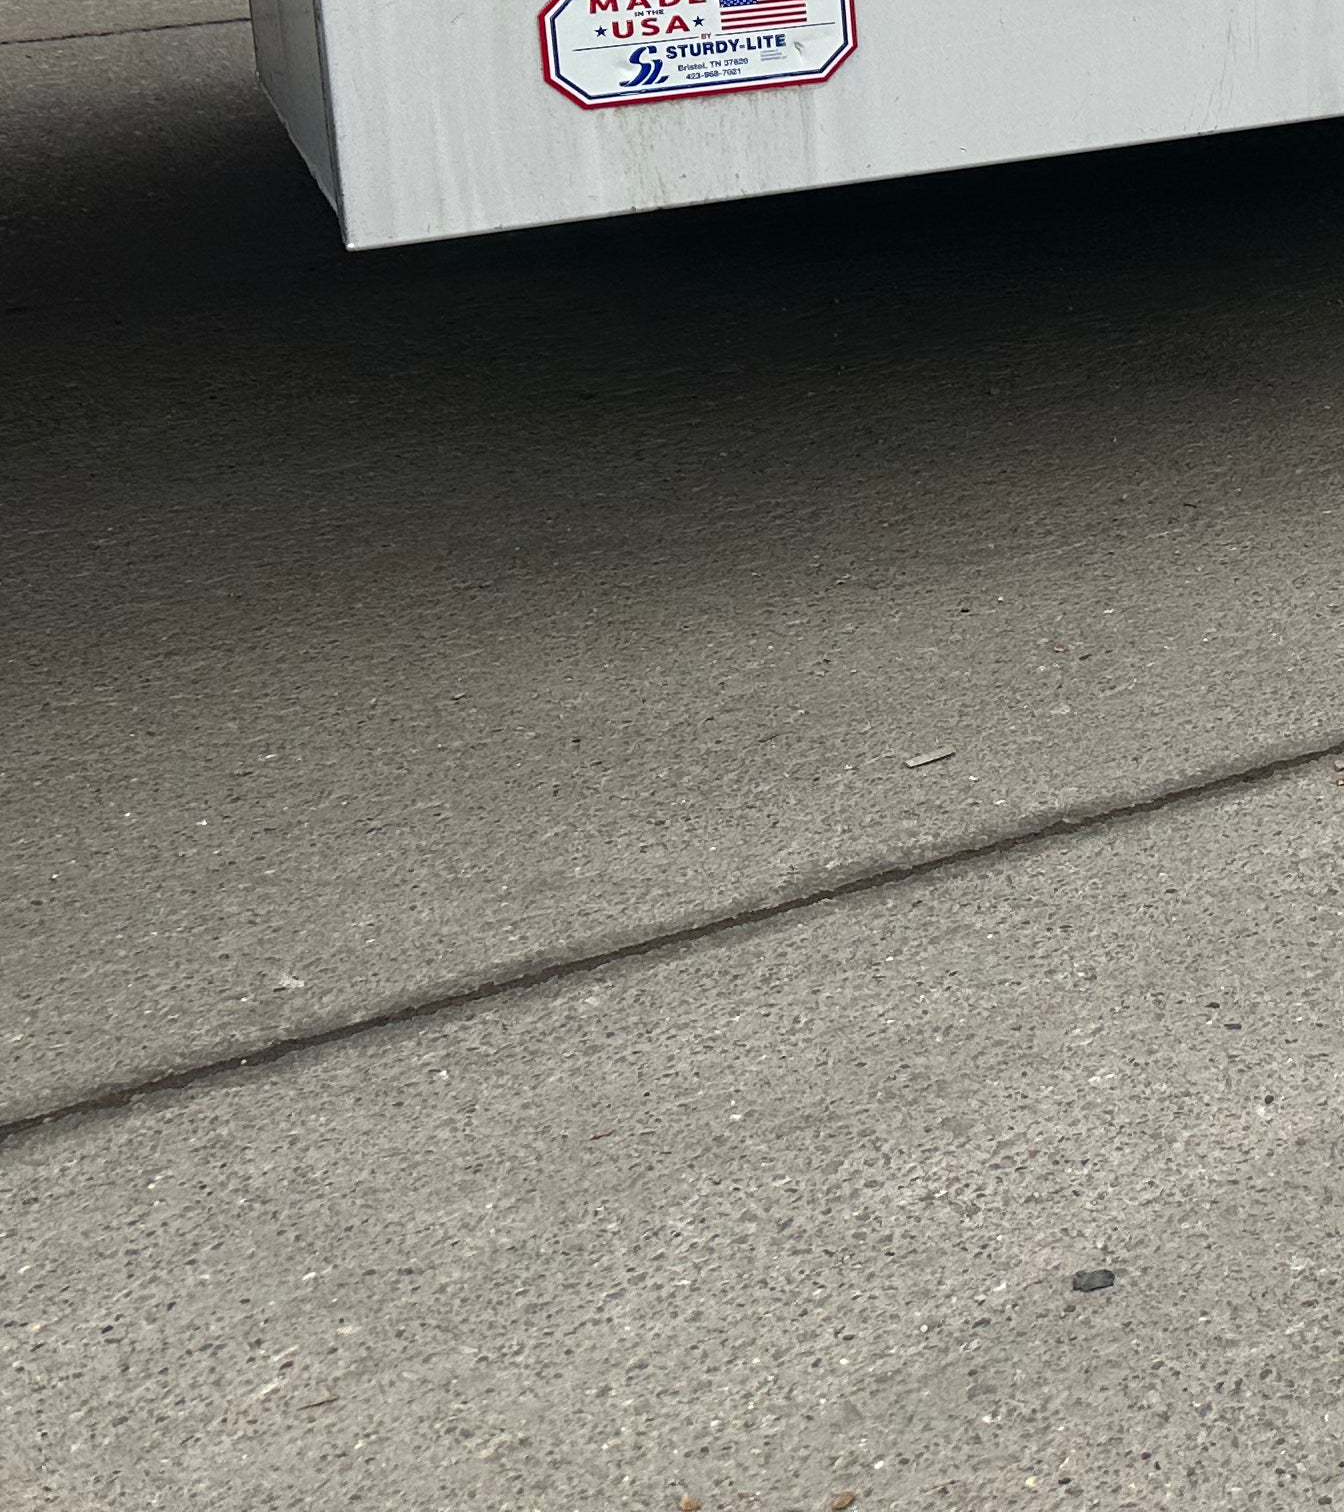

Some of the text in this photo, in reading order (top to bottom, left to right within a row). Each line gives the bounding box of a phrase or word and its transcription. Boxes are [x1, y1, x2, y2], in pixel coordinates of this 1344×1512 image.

[646, 8, 665, 16] THE
[611, 14, 691, 39] USA
[666, 33, 787, 59] STURDY-LITE
[710, 59, 722, 68] TN
